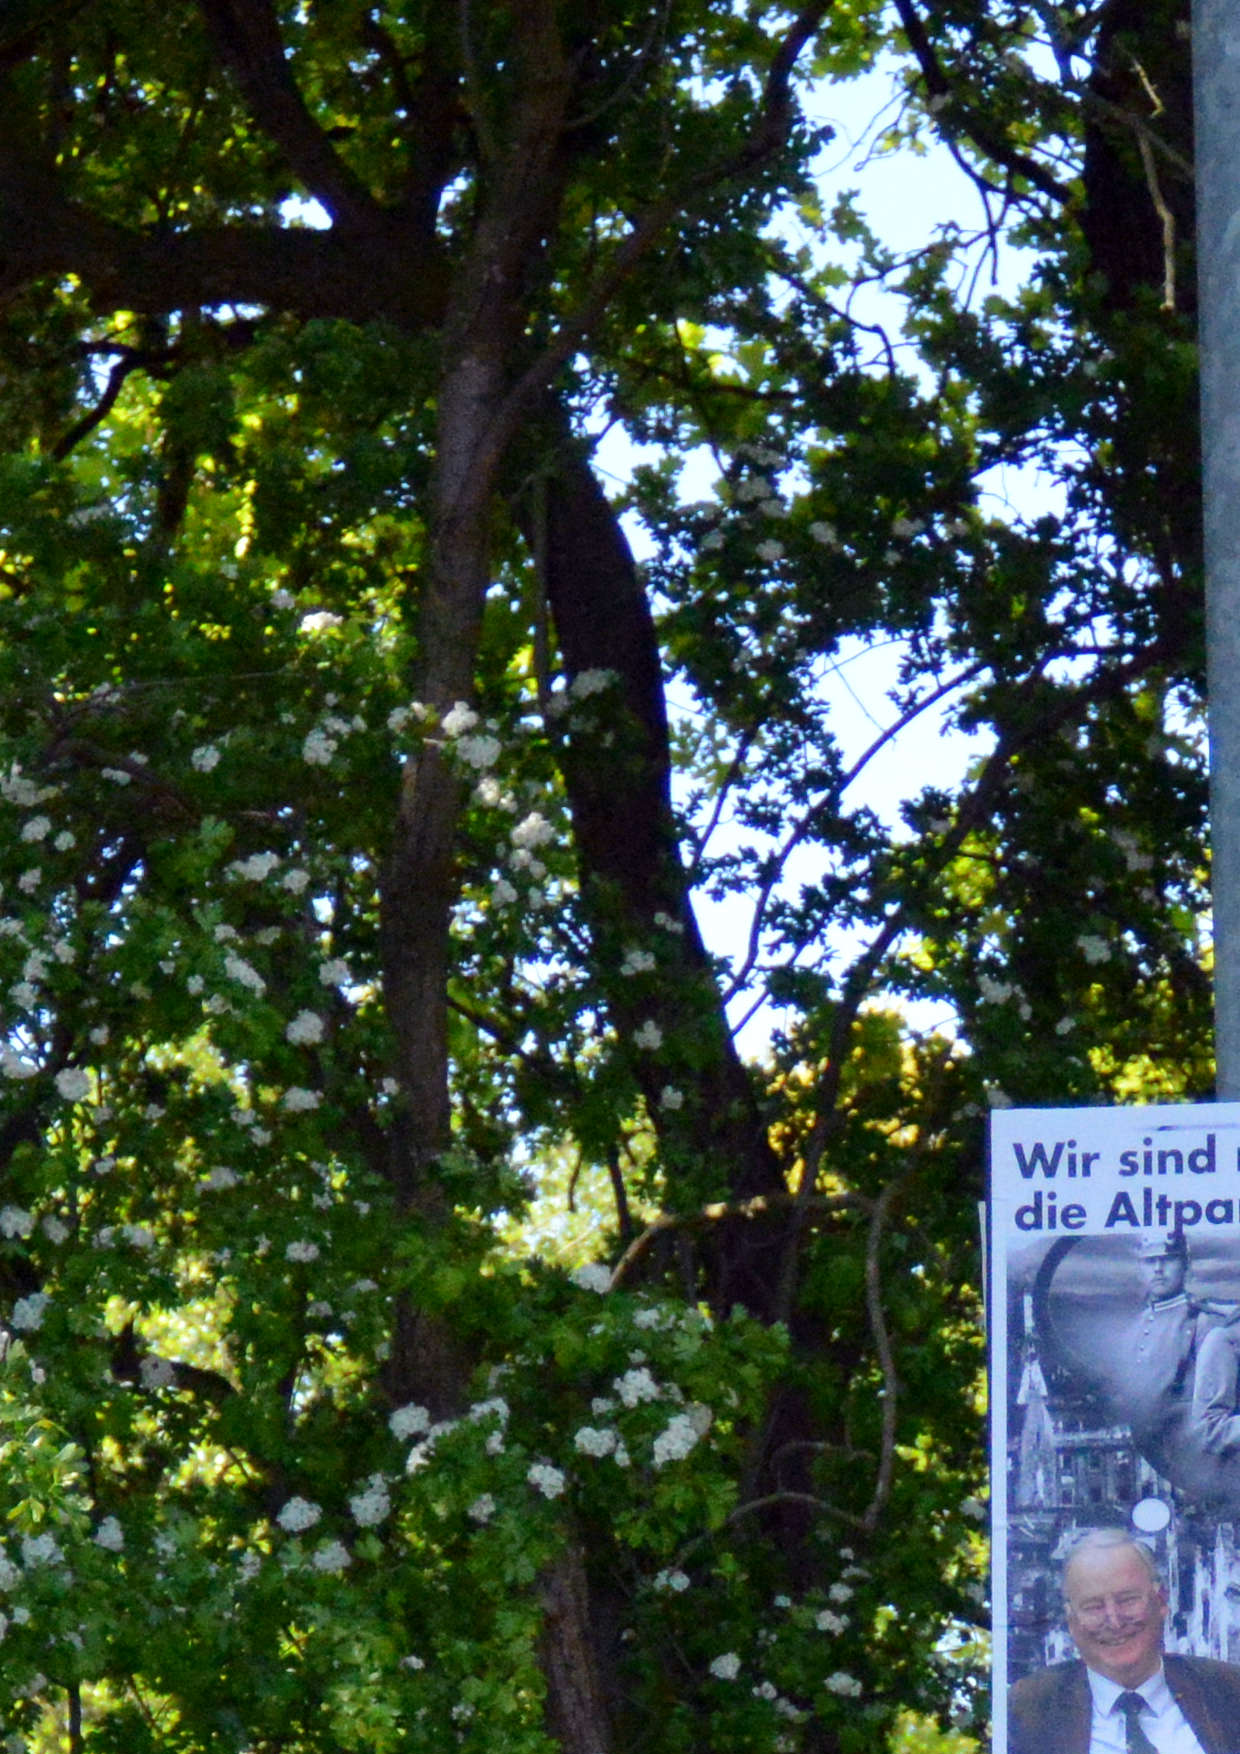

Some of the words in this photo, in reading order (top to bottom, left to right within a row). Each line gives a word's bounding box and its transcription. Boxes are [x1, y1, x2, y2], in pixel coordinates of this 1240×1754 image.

[1012, 1139, 1100, 1179] Wir
[1118, 1133, 1216, 1177] sind
[1014, 1190, 1087, 1231] die
